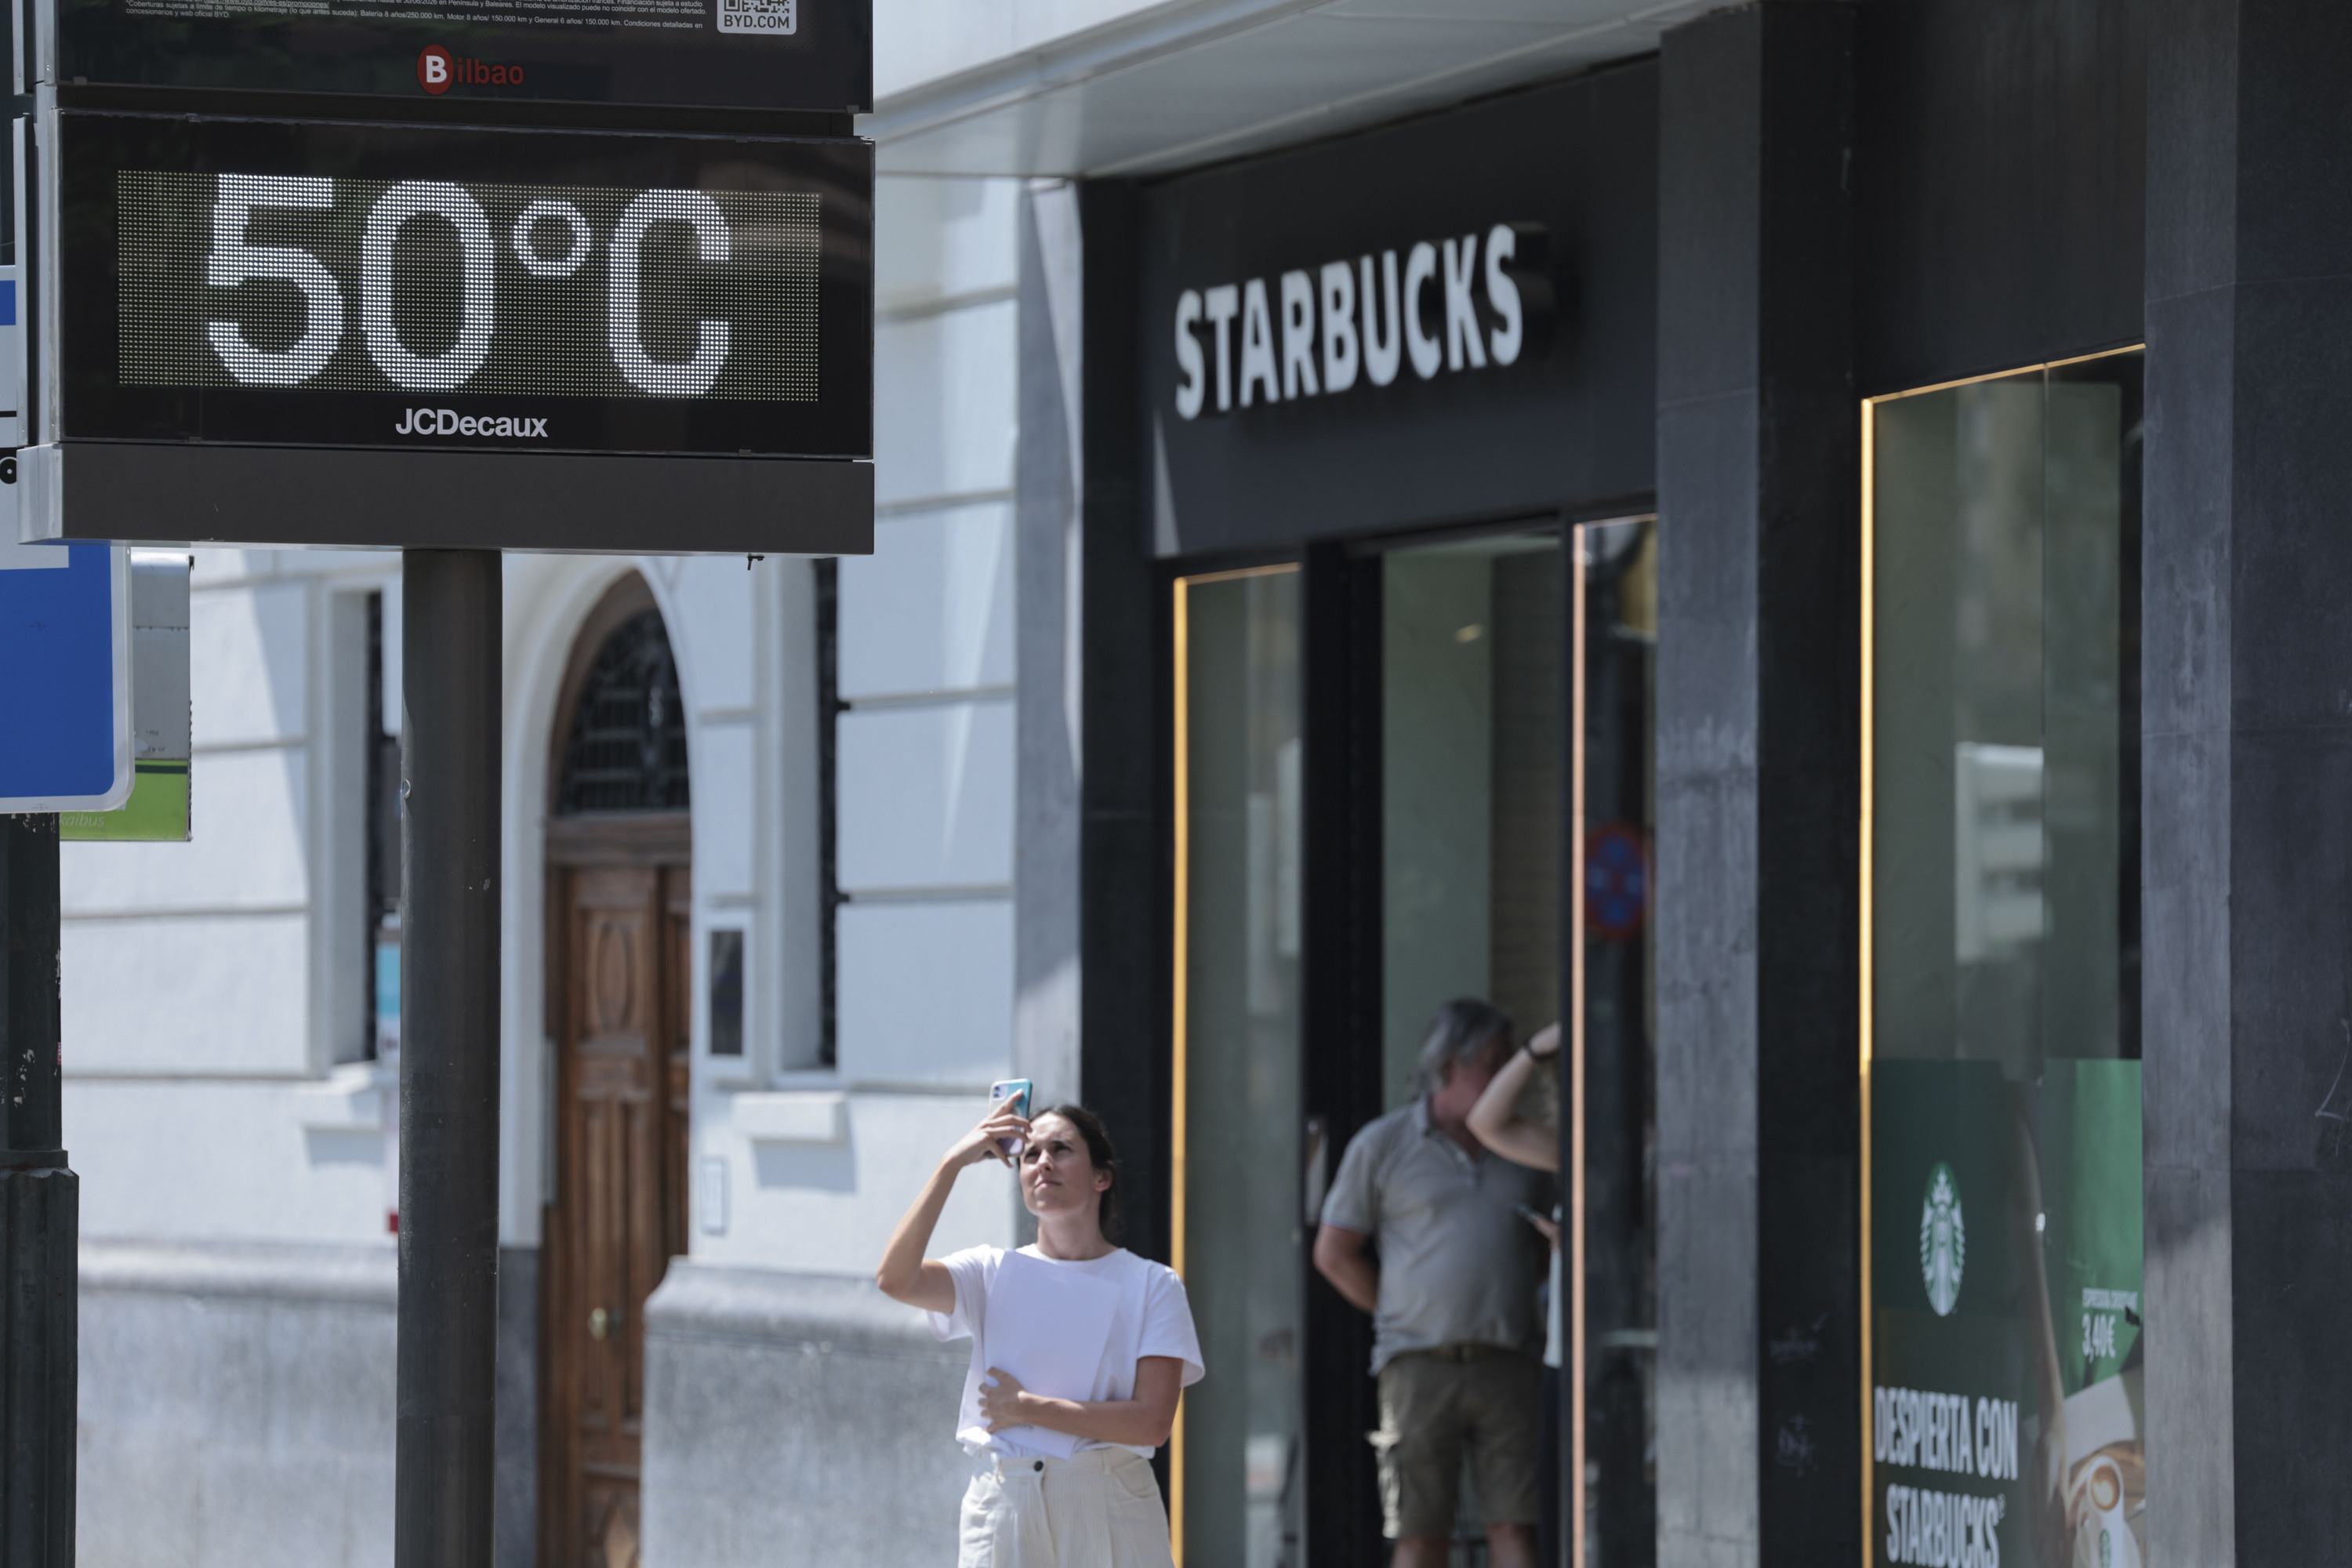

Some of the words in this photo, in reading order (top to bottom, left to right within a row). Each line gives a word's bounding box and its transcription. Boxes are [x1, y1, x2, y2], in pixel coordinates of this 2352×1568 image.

[253, 5, 288, 14] kilometraje
[724, 14, 789, 28] BYD.COM
[426, 55, 524, 85] Bilbao
[208, 173, 730, 394] 50°C
[1175, 223, 1523, 419] STARBUCKS
[396, 408, 548, 437] JCDecaux
[1875, 1385, 1973, 1475] DESPIERTA
[1976, 1396, 2018, 1480] CON
